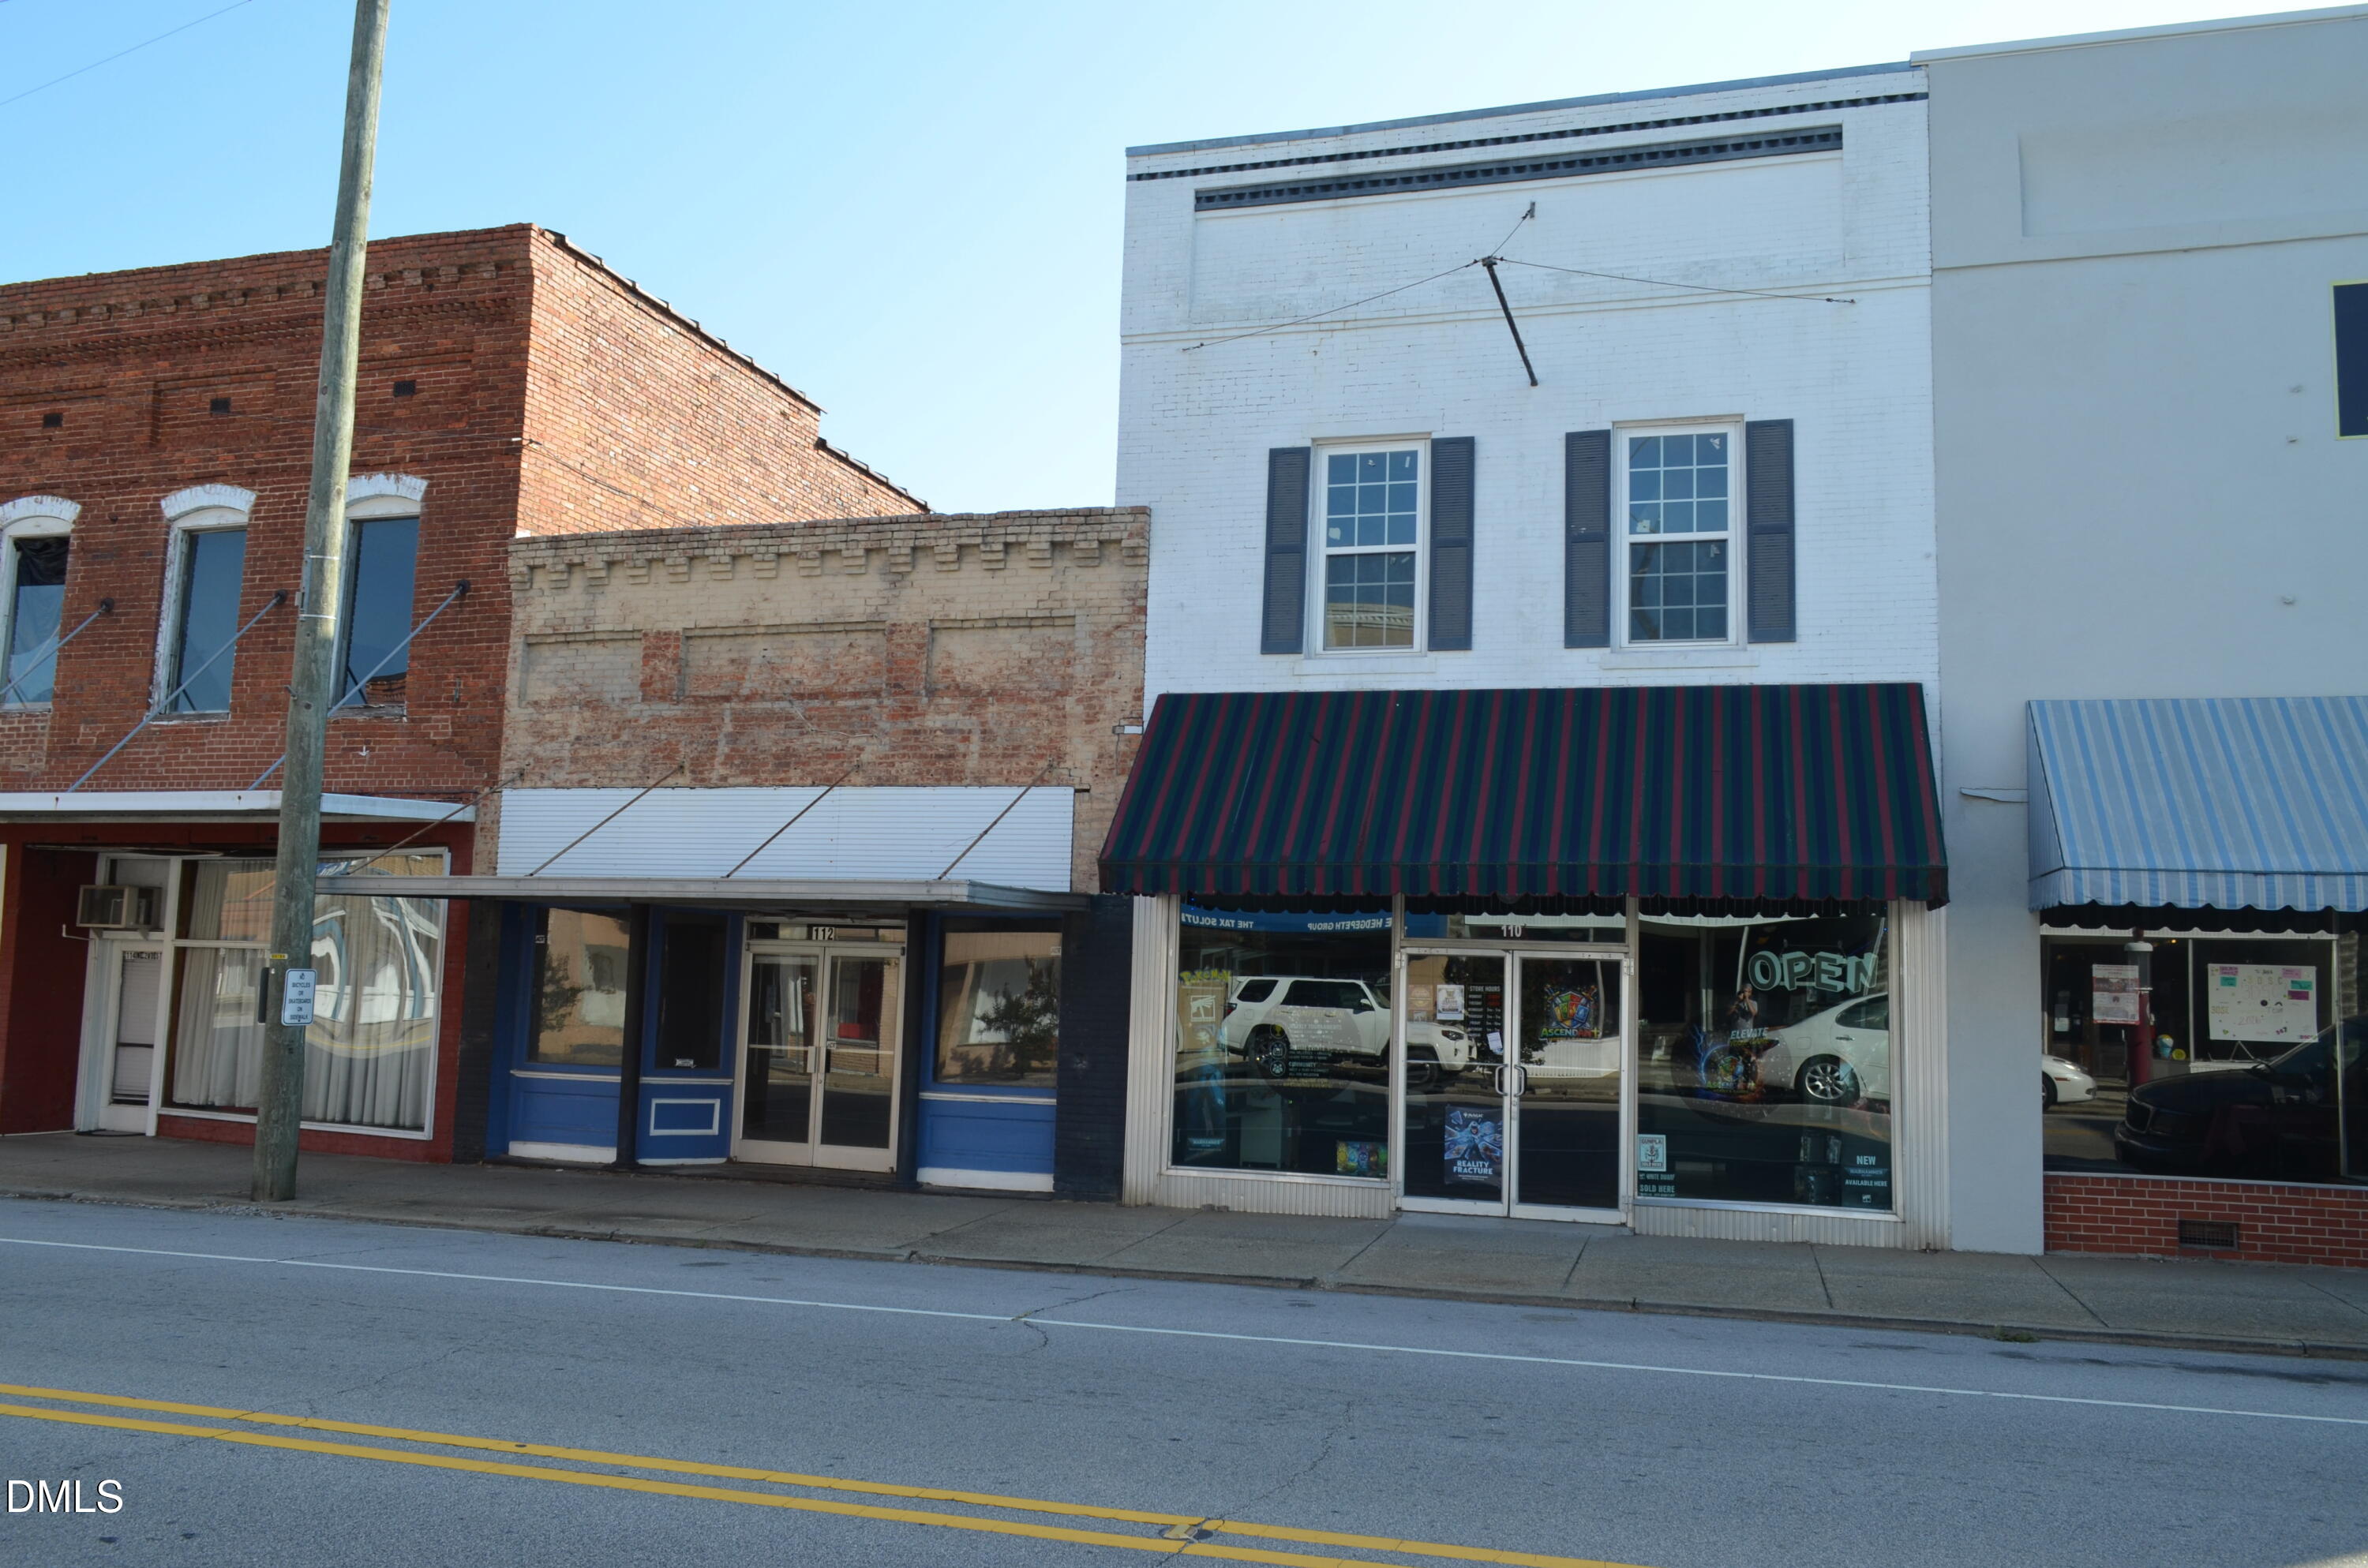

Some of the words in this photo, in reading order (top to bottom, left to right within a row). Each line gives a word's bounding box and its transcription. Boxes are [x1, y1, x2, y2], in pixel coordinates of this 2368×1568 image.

[815, 927, 834, 941] 112
[1501, 925, 1522, 937] 110
[1748, 950, 1879, 994] OPEN
[1730, 1027, 1768, 1038] ELEVATE
[1857, 1155, 1876, 1166] NEW
[1453, 1166, 1493, 1175] FRACTURE
